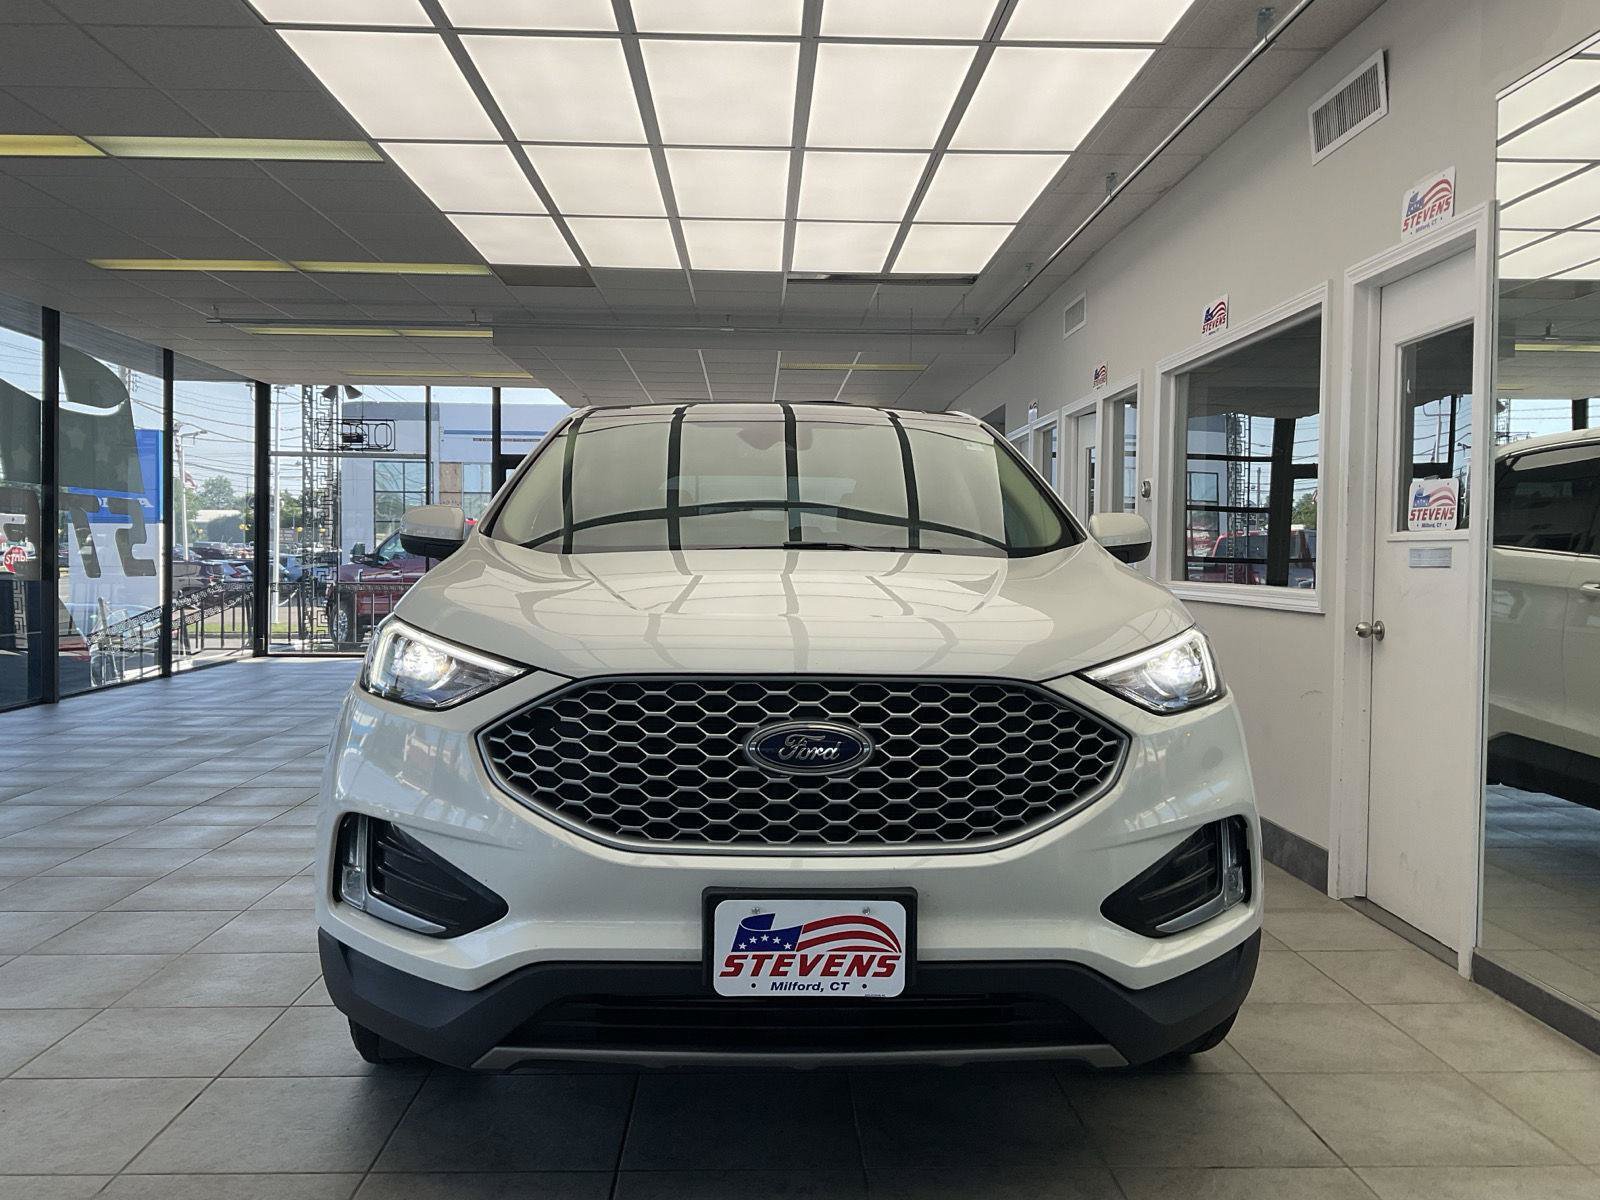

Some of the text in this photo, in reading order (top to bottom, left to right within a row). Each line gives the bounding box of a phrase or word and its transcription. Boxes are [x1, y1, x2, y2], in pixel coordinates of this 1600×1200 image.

[1402, 195, 1453, 233] STEVENS
[1201, 314, 1227, 334] STEVENS
[1409, 507, 1456, 521] STEVENS
[777, 733, 842, 761] Ford
[719, 953, 902, 978] STEVENS
[770, 981, 850, 993] Milford, CT
